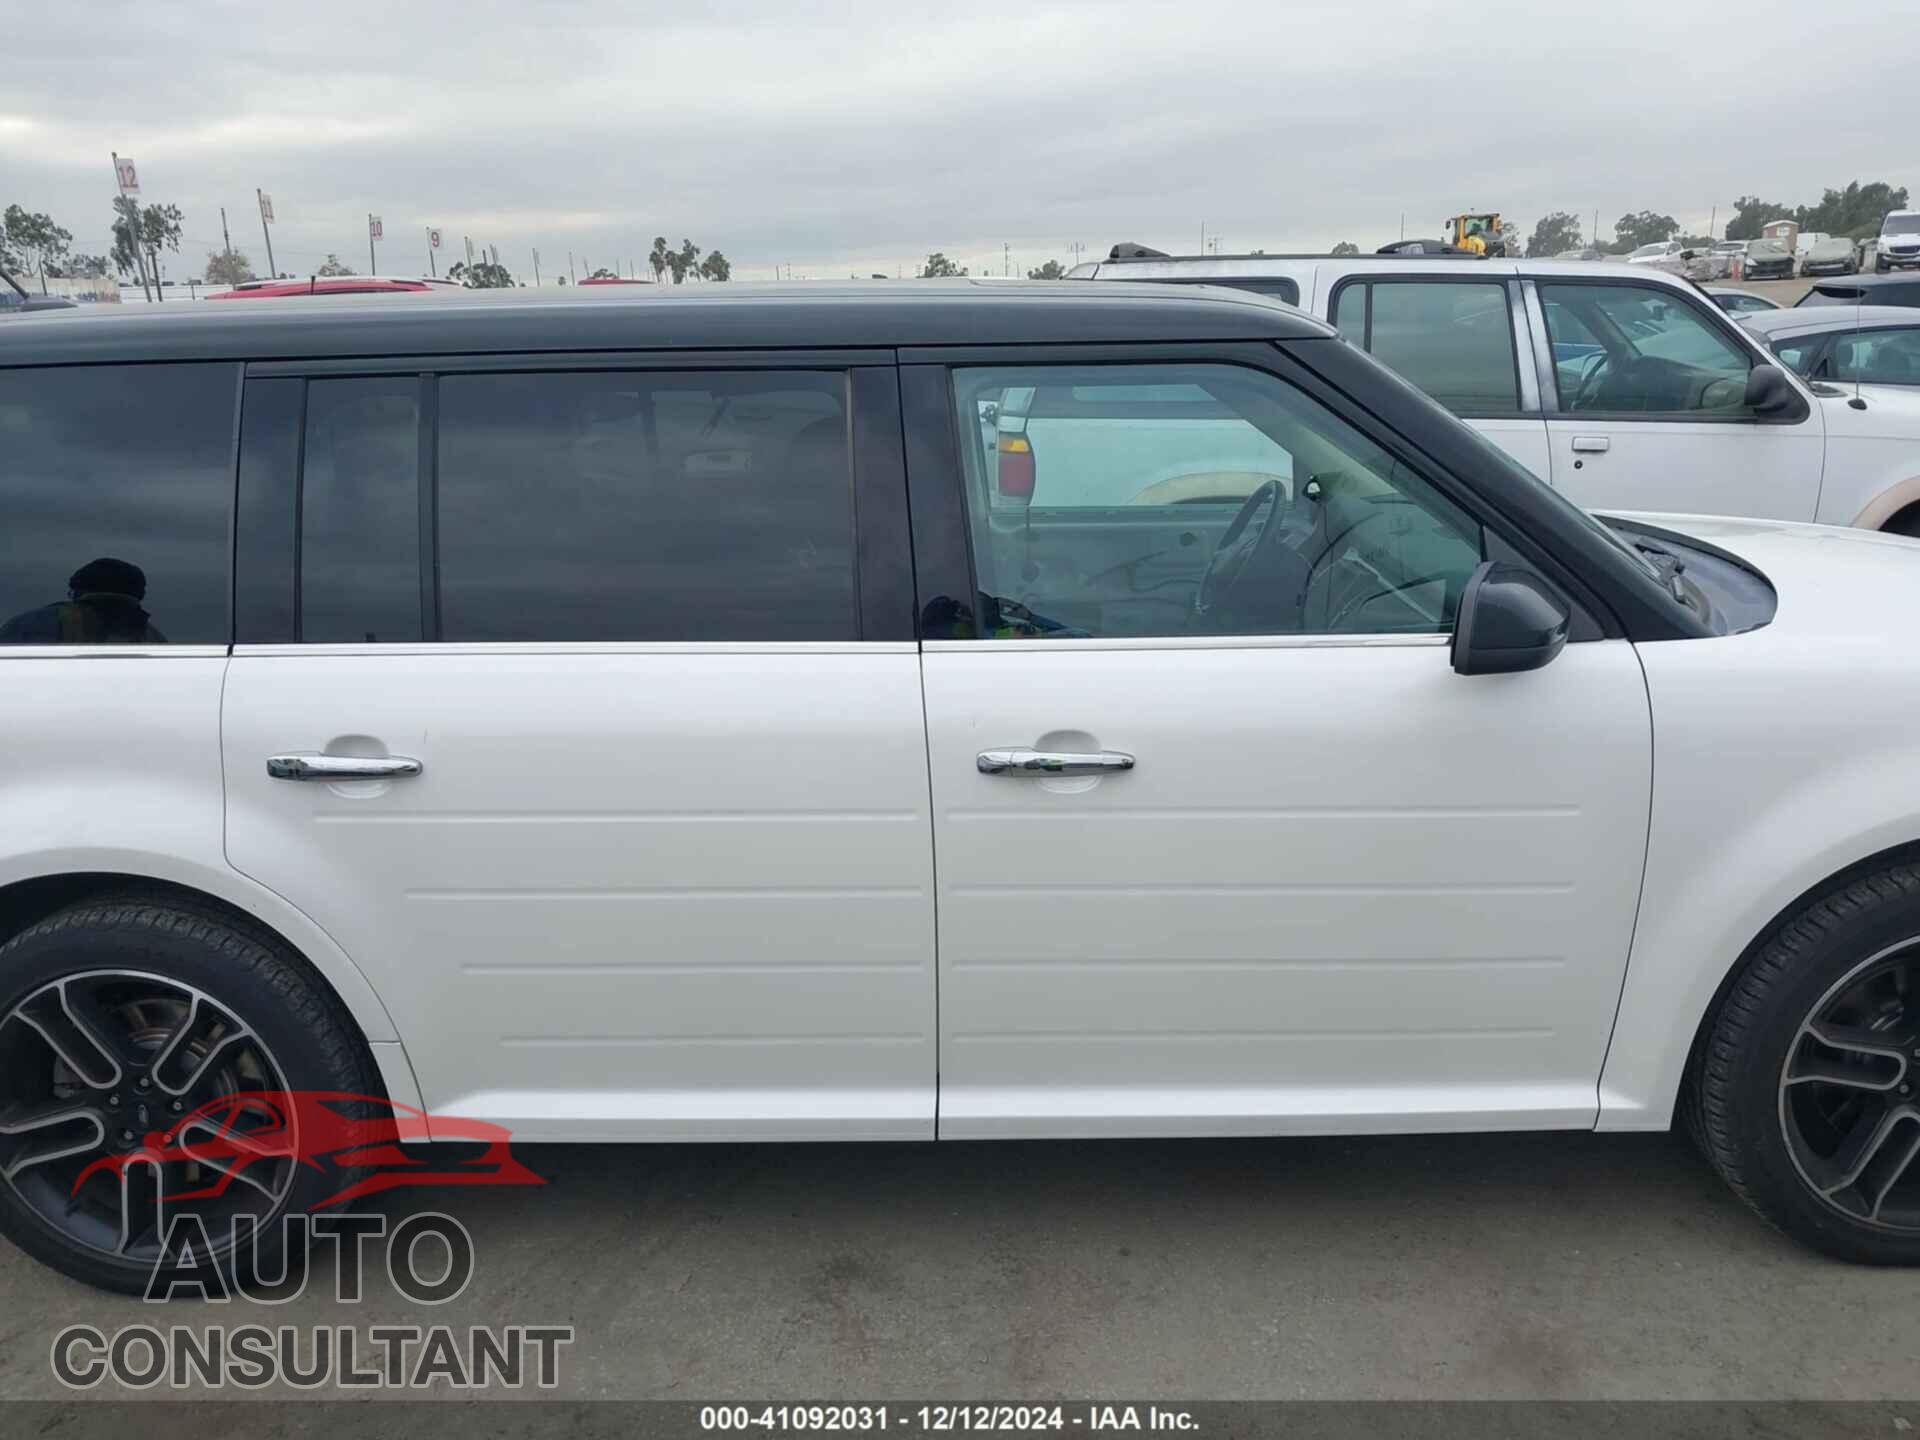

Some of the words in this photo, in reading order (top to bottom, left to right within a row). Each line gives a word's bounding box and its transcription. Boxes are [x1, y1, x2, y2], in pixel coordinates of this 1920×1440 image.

[119, 165, 138, 188] 12
[263, 200, 275, 219] 11
[371, 221, 383, 237] 10
[431, 231, 440, 248] 9
